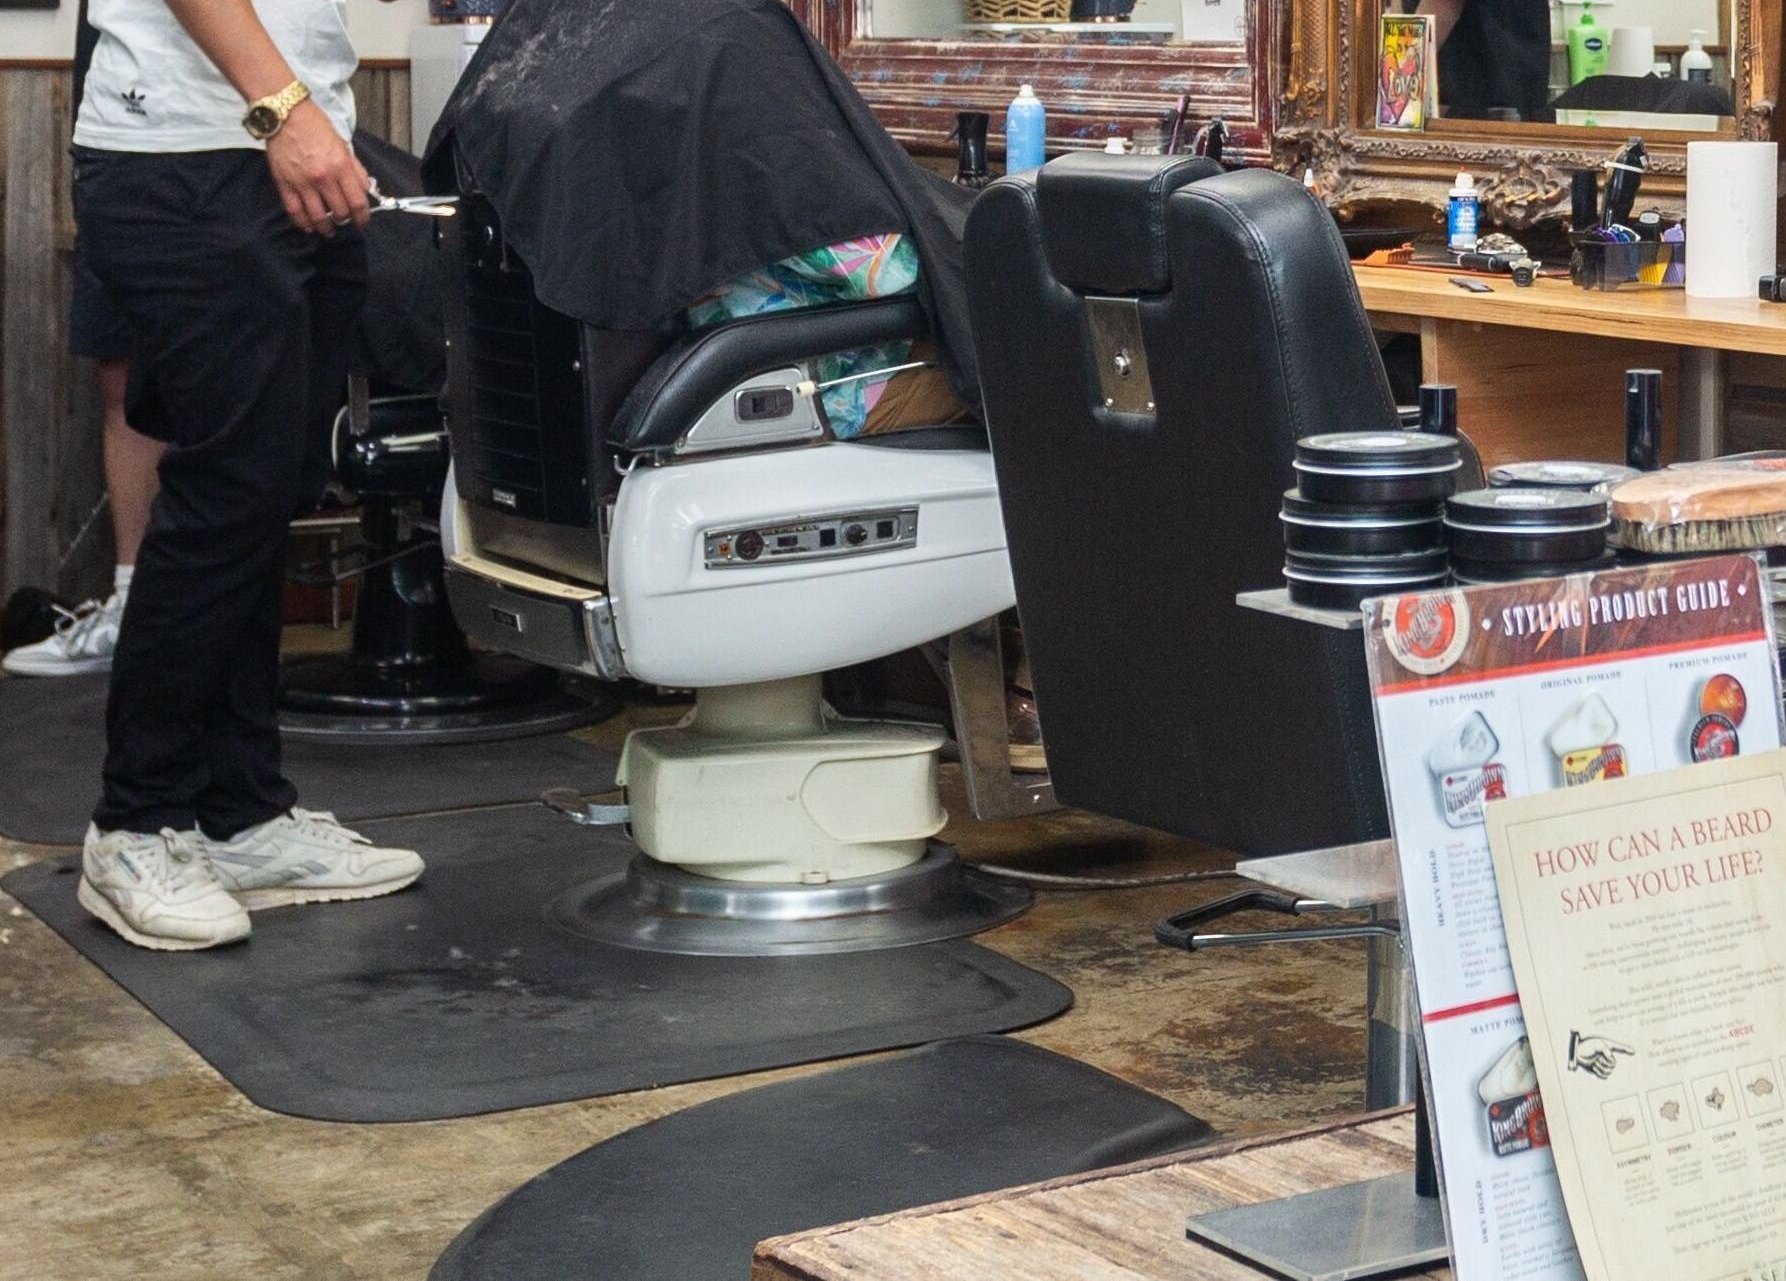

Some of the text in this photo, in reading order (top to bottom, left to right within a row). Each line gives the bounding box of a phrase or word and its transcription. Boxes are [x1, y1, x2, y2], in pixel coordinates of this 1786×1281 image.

[1502, 578, 1731, 637] STYLING PRODUCT GUIDE
[1712, 651, 1749, 665] POMADE
[1458, 689, 1497, 703] POMADE
[1540, 670, 1622, 690] ORIGINAL POMADE
[1533, 807, 1773, 879] HOW CAN A BEARD
[1560, 852, 1764, 916] SAVE YOUR LIFE?
